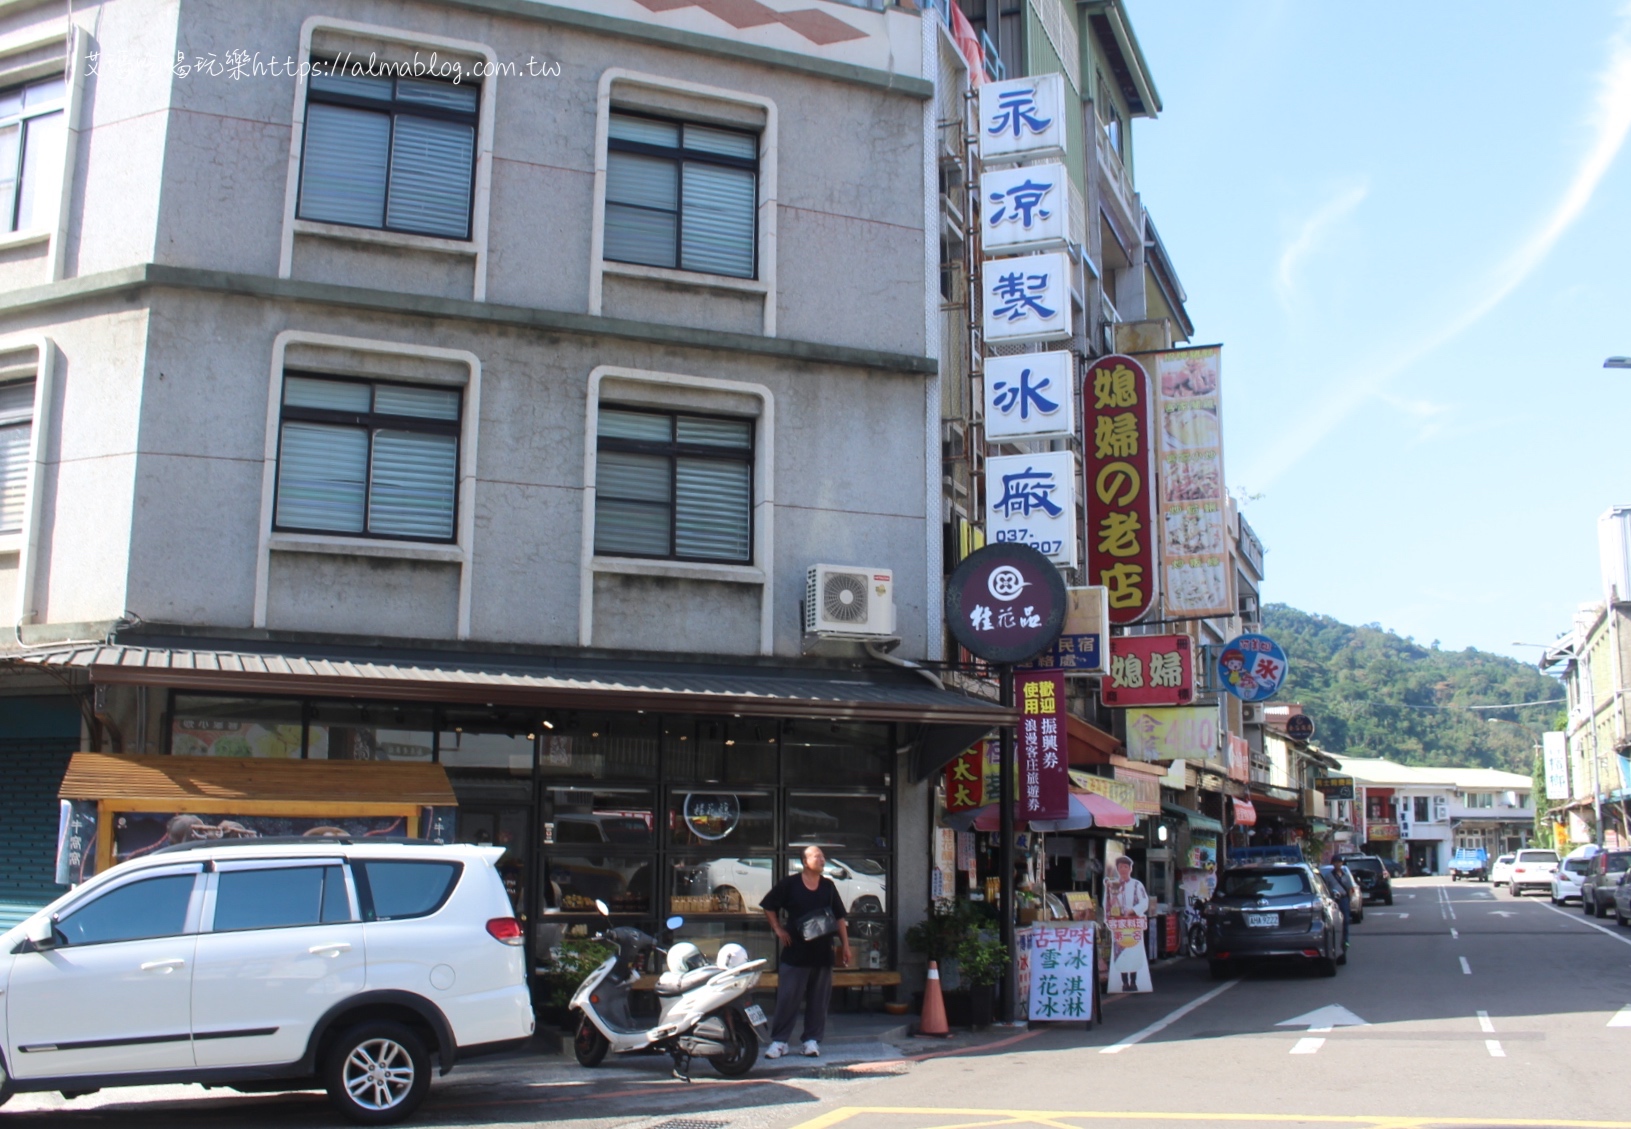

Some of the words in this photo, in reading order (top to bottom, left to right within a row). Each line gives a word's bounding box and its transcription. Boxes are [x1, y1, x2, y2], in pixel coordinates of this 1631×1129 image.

[1093, 364, 1143, 611] 媳婦の老店
[969, 604, 1042, 632] 桂花品
[1048, 636, 1096, 653] 民宿
[1111, 651, 1184, 689] 媳婦
[1023, 682, 1039, 714] 使用
[1039, 681, 1056, 714] 歡迎
[1041, 717, 1059, 769] 振興券
[1033, 926, 1094, 949] 古早味
[1036, 949, 1063, 1018] 雪花冰
[1062, 949, 1088, 1018] 冰淇淋
